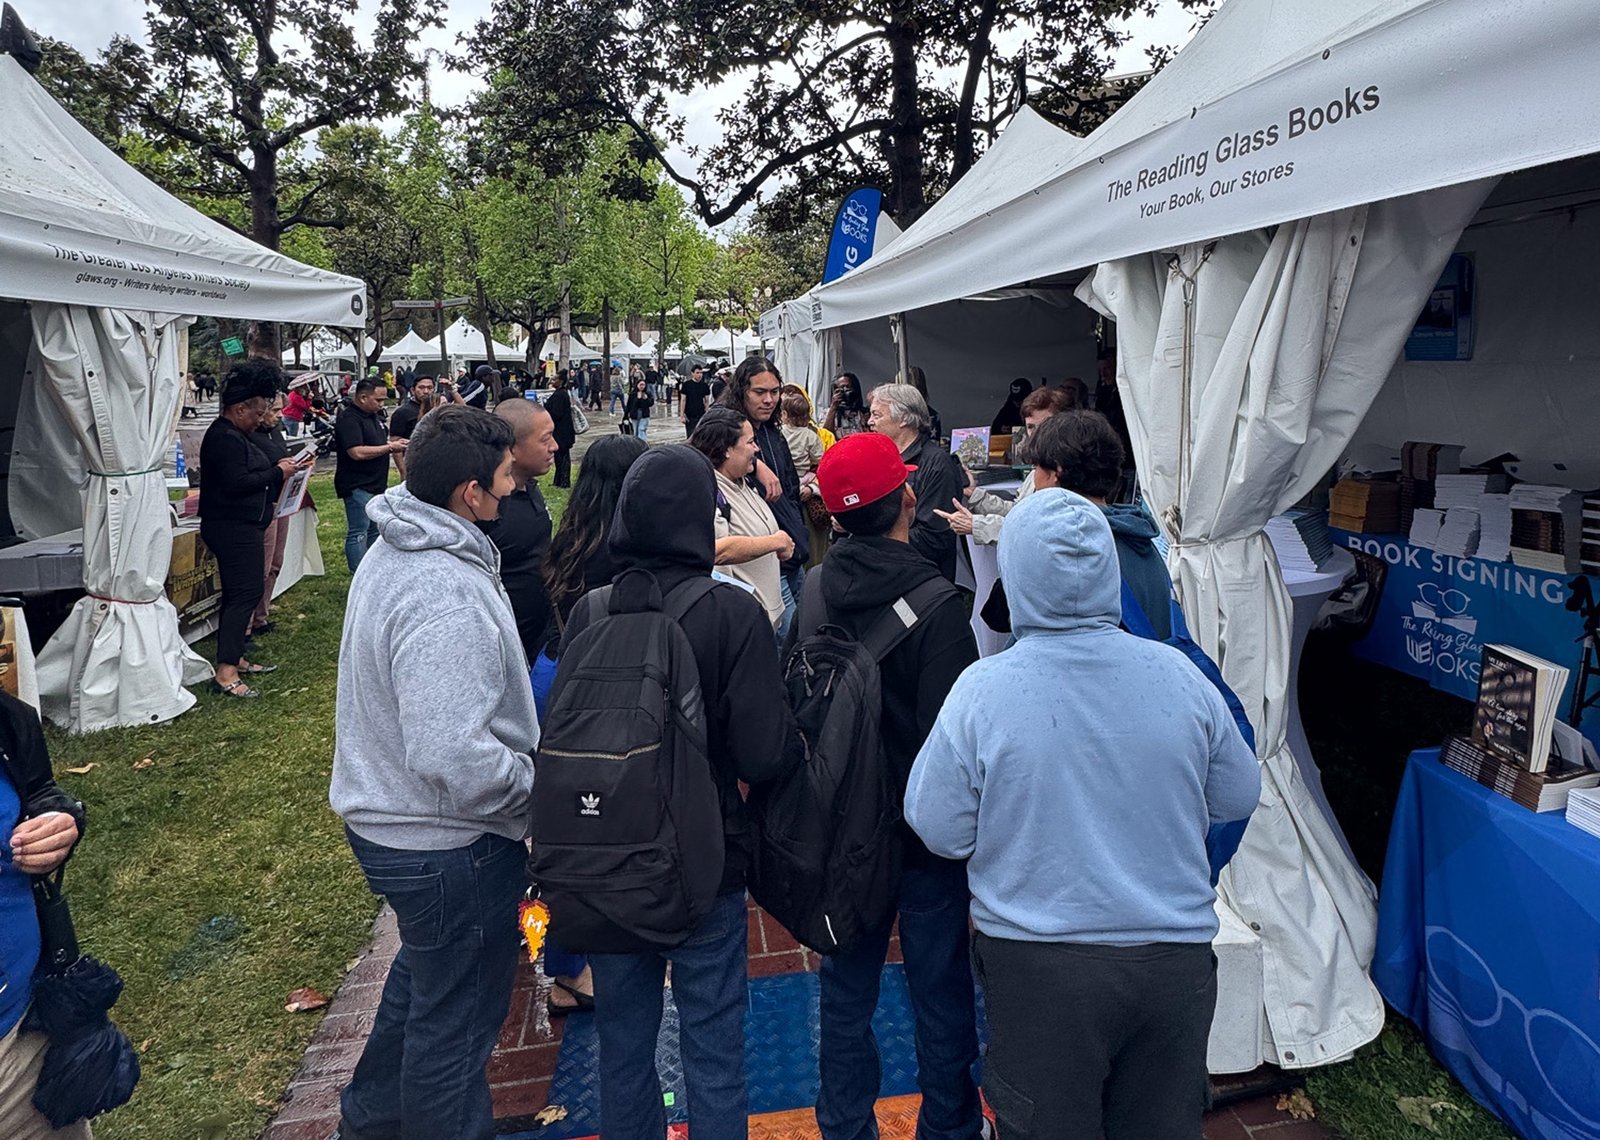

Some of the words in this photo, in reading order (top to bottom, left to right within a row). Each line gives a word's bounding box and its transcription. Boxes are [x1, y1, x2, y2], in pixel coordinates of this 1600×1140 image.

[1107, 180, 1132, 203] The
[1136, 150, 1209, 193] Reading
[1215, 124, 1279, 163] Glass
[1288, 85, 1380, 139] Books
[1140, 202, 1166, 219] Your
[1168, 187, 1204, 210] Book,
[1209, 178, 1237, 198] Our
[1240, 161, 1295, 189] Stores
[75, 272, 119, 289] glaws.org
[124, 278, 150, 291] Writers
[151, 282, 177, 296] helping
[176, 286, 197, 297] writers
[1431, 552, 1564, 605] SIGNING
[1401, 616, 1418, 632] The
[580, 808, 600, 816] adidas
